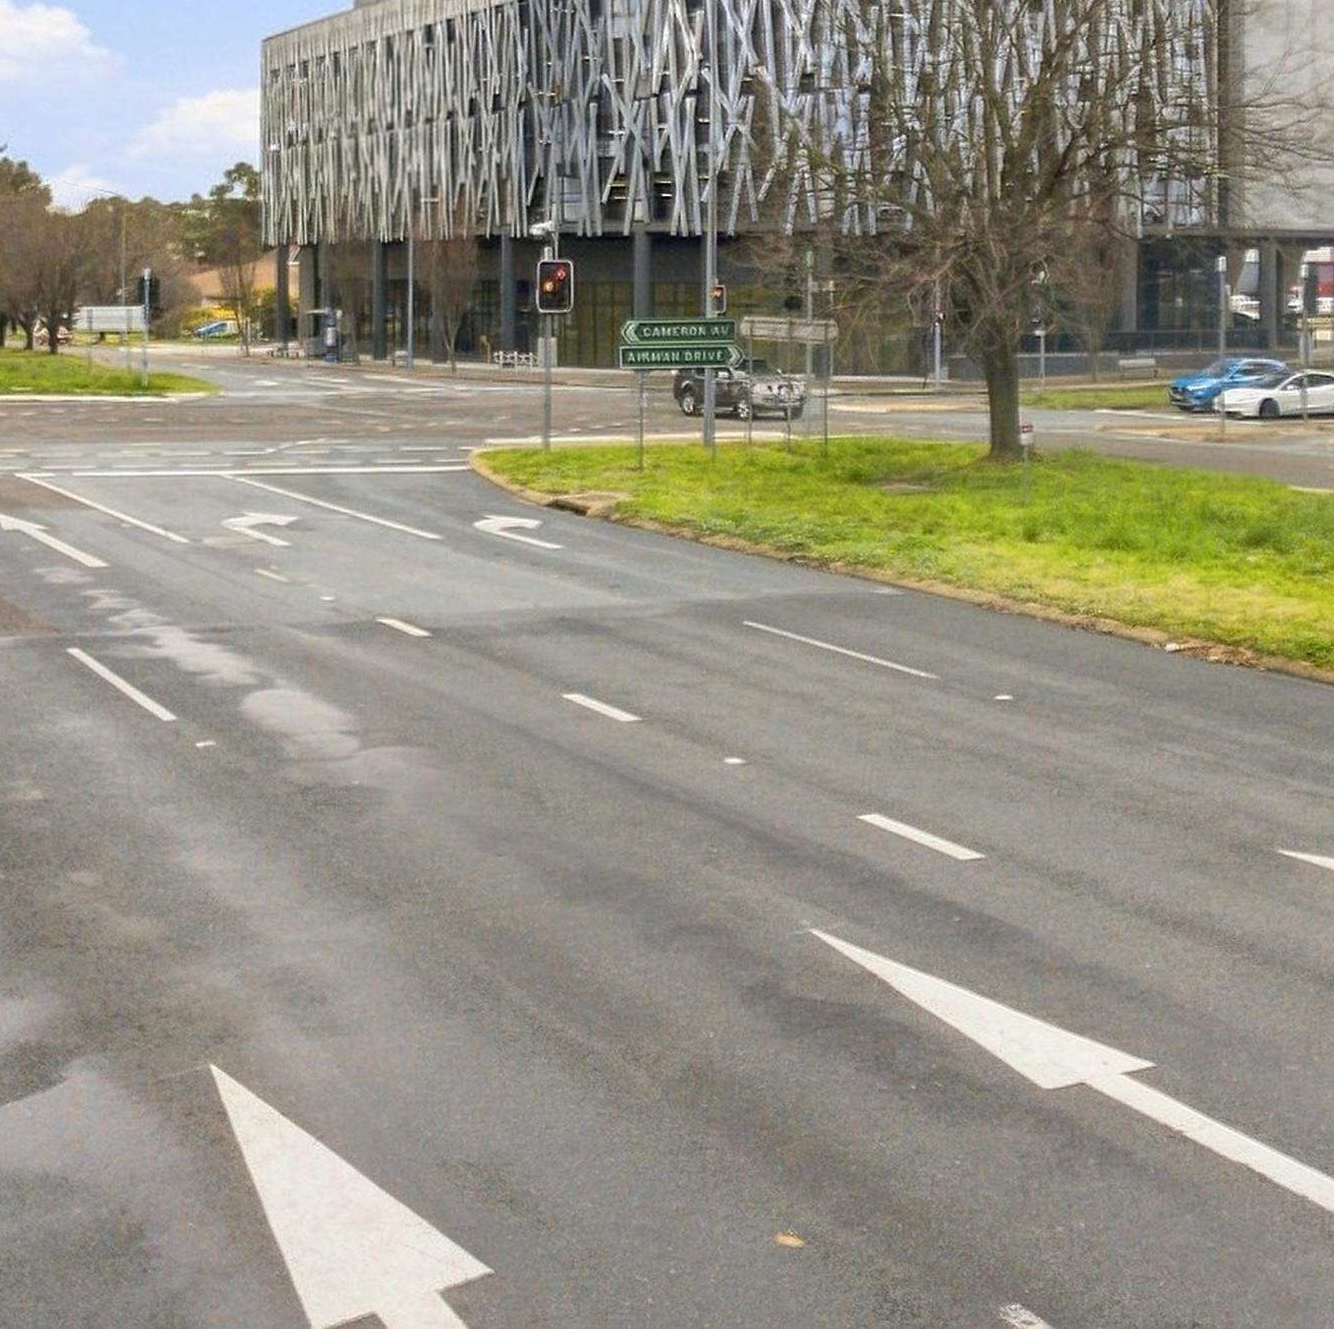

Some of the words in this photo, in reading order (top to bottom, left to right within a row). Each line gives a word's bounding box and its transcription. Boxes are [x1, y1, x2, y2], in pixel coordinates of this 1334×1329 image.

[643, 326, 707, 338] CAMERON
[627, 351, 680, 363] AIKMAN
[684, 351, 724, 362] DRIVE
